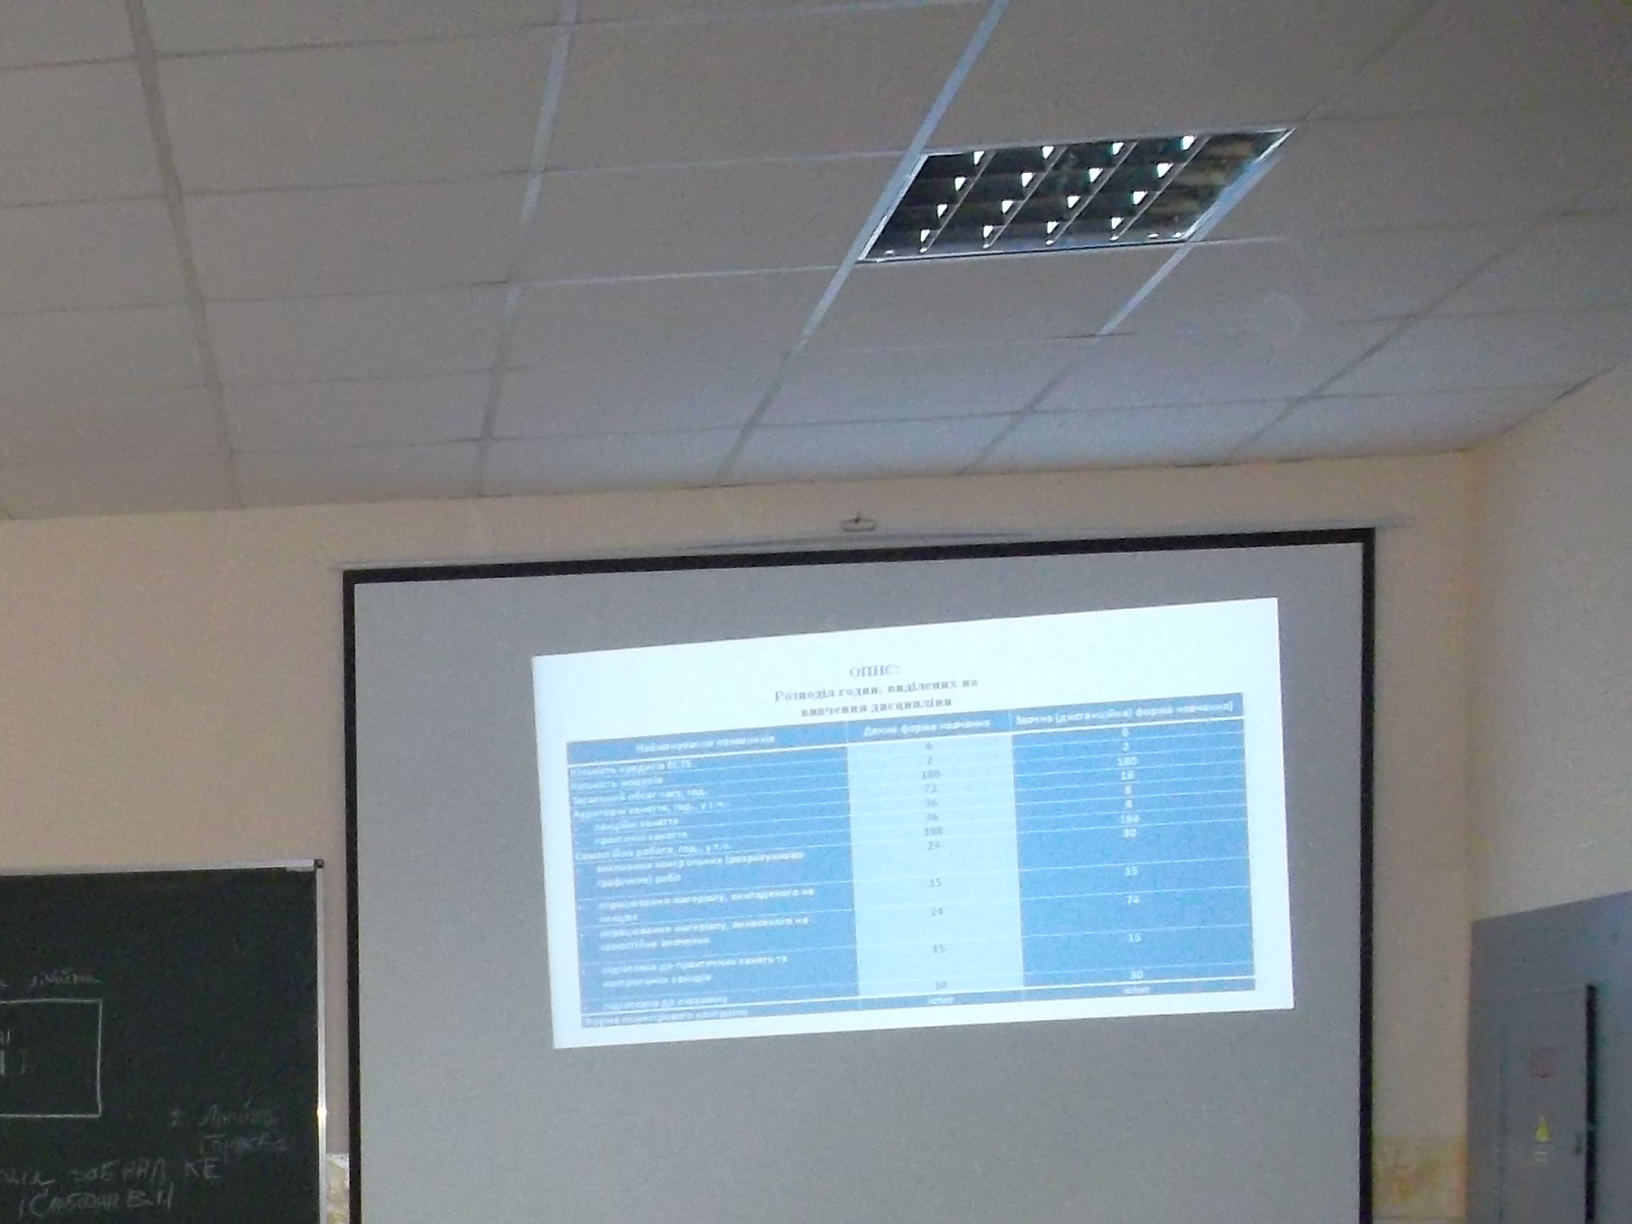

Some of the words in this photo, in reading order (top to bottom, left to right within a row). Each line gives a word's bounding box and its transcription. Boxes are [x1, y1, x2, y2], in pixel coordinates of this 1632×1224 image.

[774, 687, 835, 703] Розподіл
[962, 677, 979, 688] на
[800, 702, 867, 717] вивчення
[1135, 705, 1173, 717] форма
[899, 722, 936, 735] форма
[1117, 756, 1137, 766] 180
[1124, 866, 1138, 876] 15
[929, 877, 942, 888] 15
[1128, 932, 1142, 942] 15
[933, 944, 945, 953] 15
